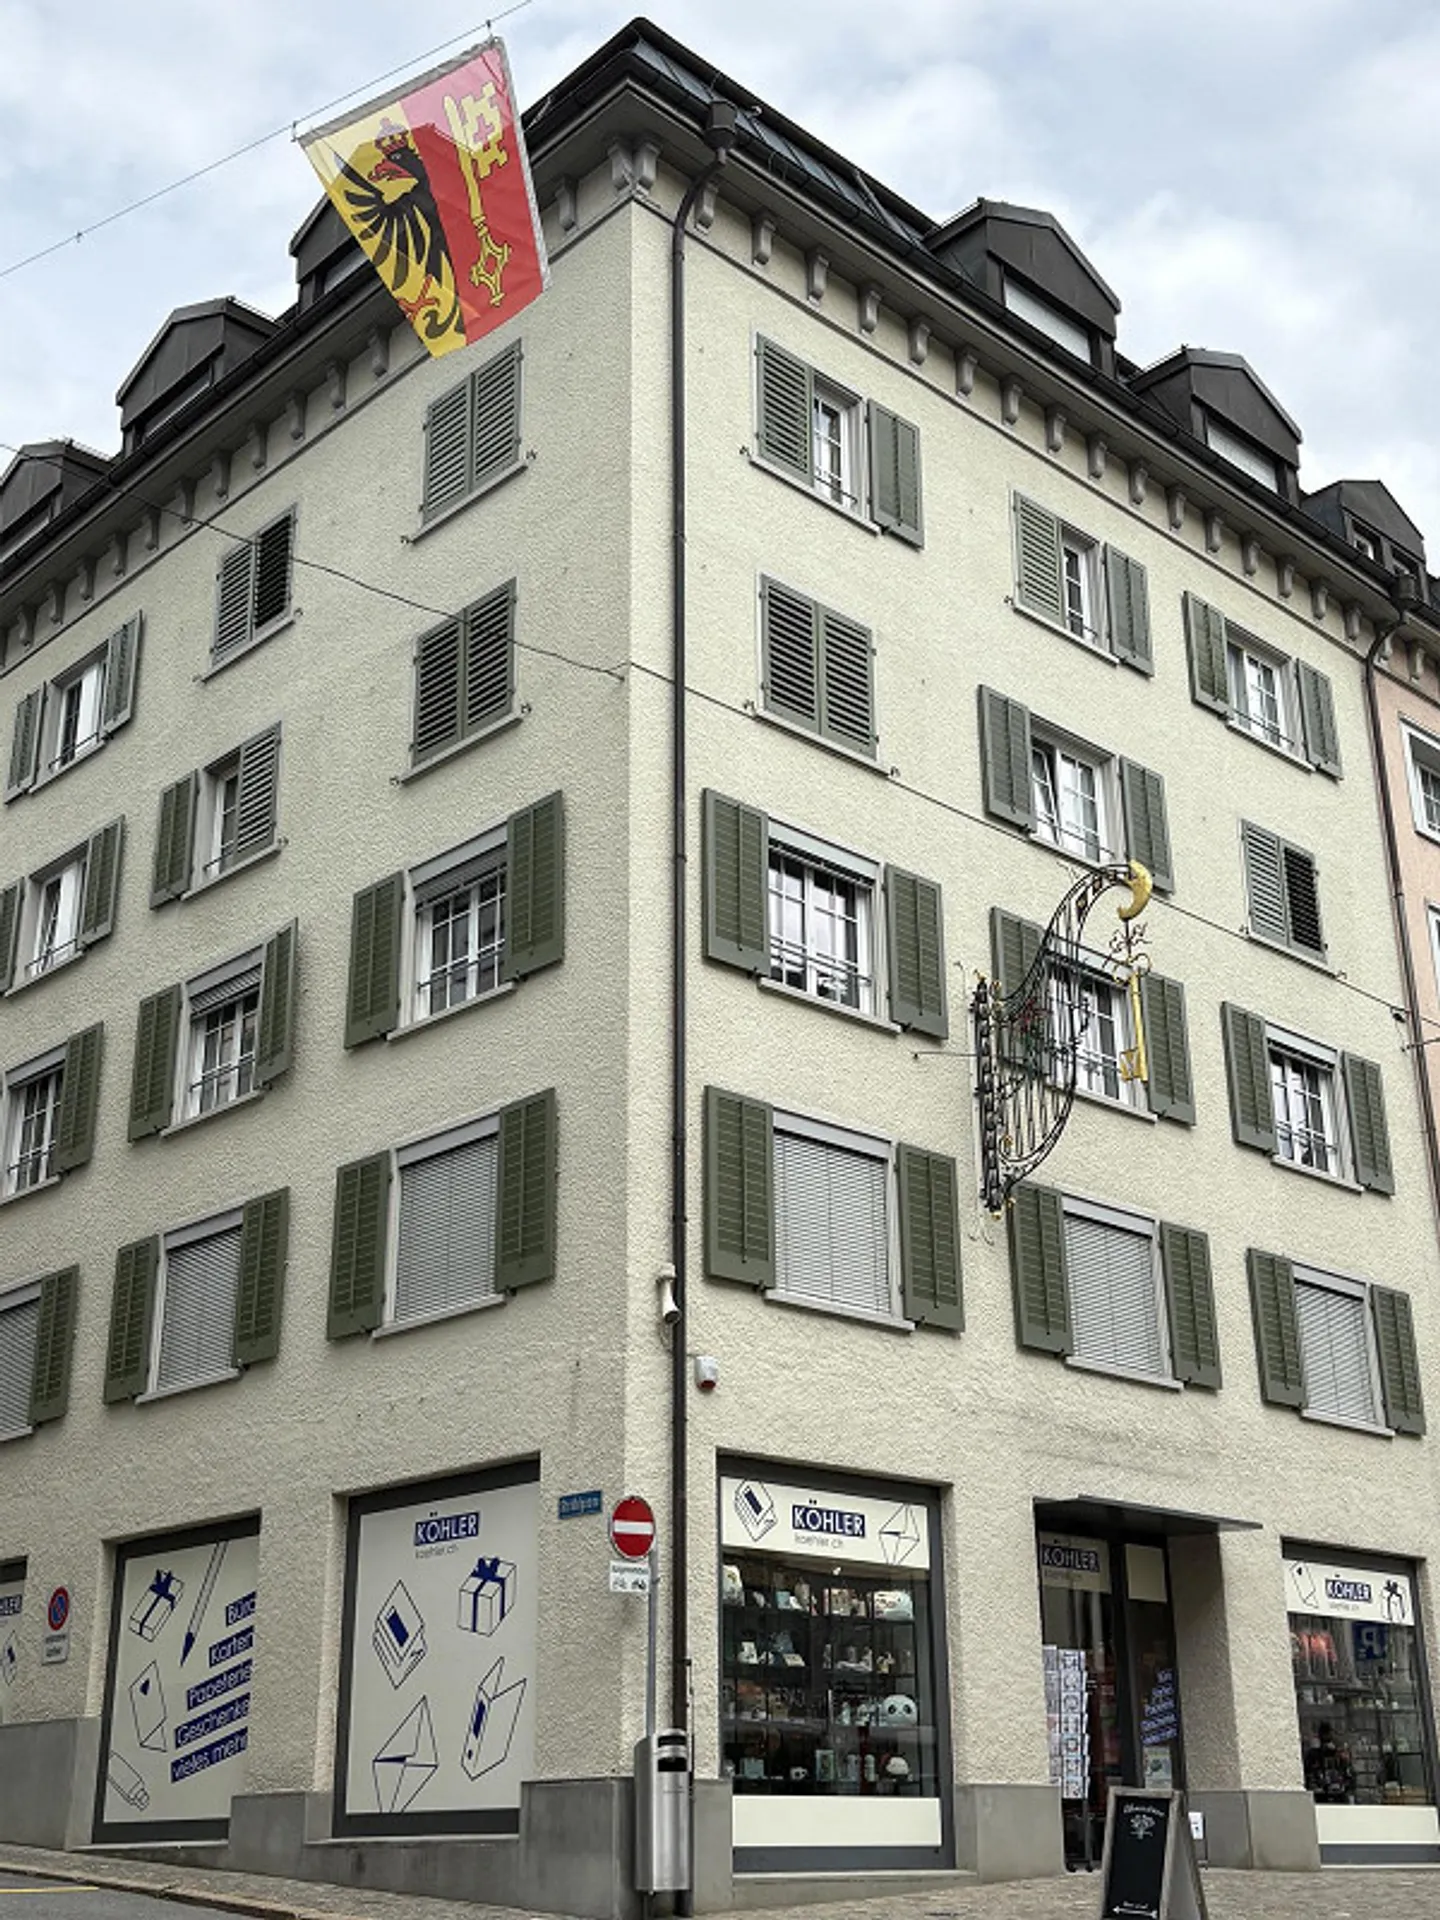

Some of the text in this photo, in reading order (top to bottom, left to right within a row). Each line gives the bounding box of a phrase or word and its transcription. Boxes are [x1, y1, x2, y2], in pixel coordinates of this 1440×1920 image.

[417, 1511, 477, 1542] KÖHLER
[794, 1499, 863, 1535] KÖHLER
[1043, 1539, 1098, 1570] KÖHLER
[1327, 1574, 1369, 1600] KÖHLER
[173, 1752, 210, 1777] vieles
